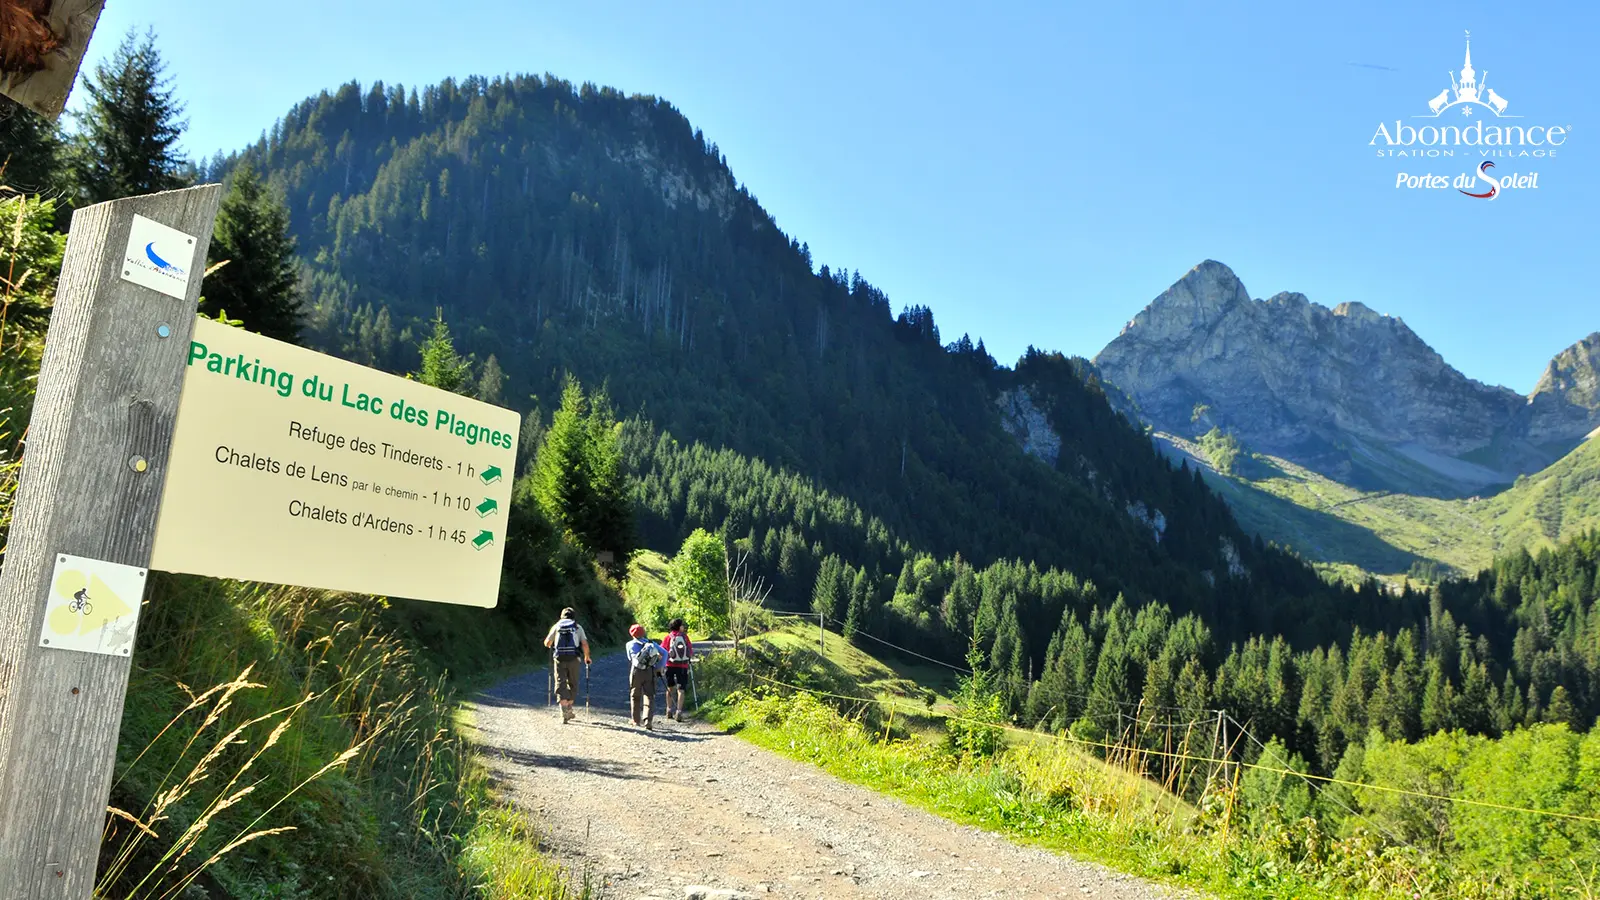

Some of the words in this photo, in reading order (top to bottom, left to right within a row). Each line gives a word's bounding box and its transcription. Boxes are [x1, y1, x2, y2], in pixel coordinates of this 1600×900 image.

[187, 341, 295, 398] Parking
[301, 375, 334, 403] du
[341, 383, 384, 415] Lac
[389, 399, 429, 428] des
[435, 409, 513, 450] Plagnes
[215, 445, 281, 474] Chalets
[285, 459, 306, 479] de
[311, 465, 349, 488] Lens
[352, 480, 369, 493] par
[372, 482, 382, 493] le
[385, 485, 419, 501] chemin
[432, 491, 438, 505] 1
[443, 492, 452, 507] h
[456, 495, 471, 512] 10
[288, 421, 345, 449] Refuge
[349, 436, 377, 456] des
[381, 442, 444, 473] Tinderets
[456, 462, 462, 476] 1
[466, 464, 475, 478] h
[288, 500, 348, 525] Chalets
[351, 512, 414, 536] d'Ardens
[427, 525, 433, 539] 1
[438, 526, 447, 541] h
[450, 529, 467, 545] 45
